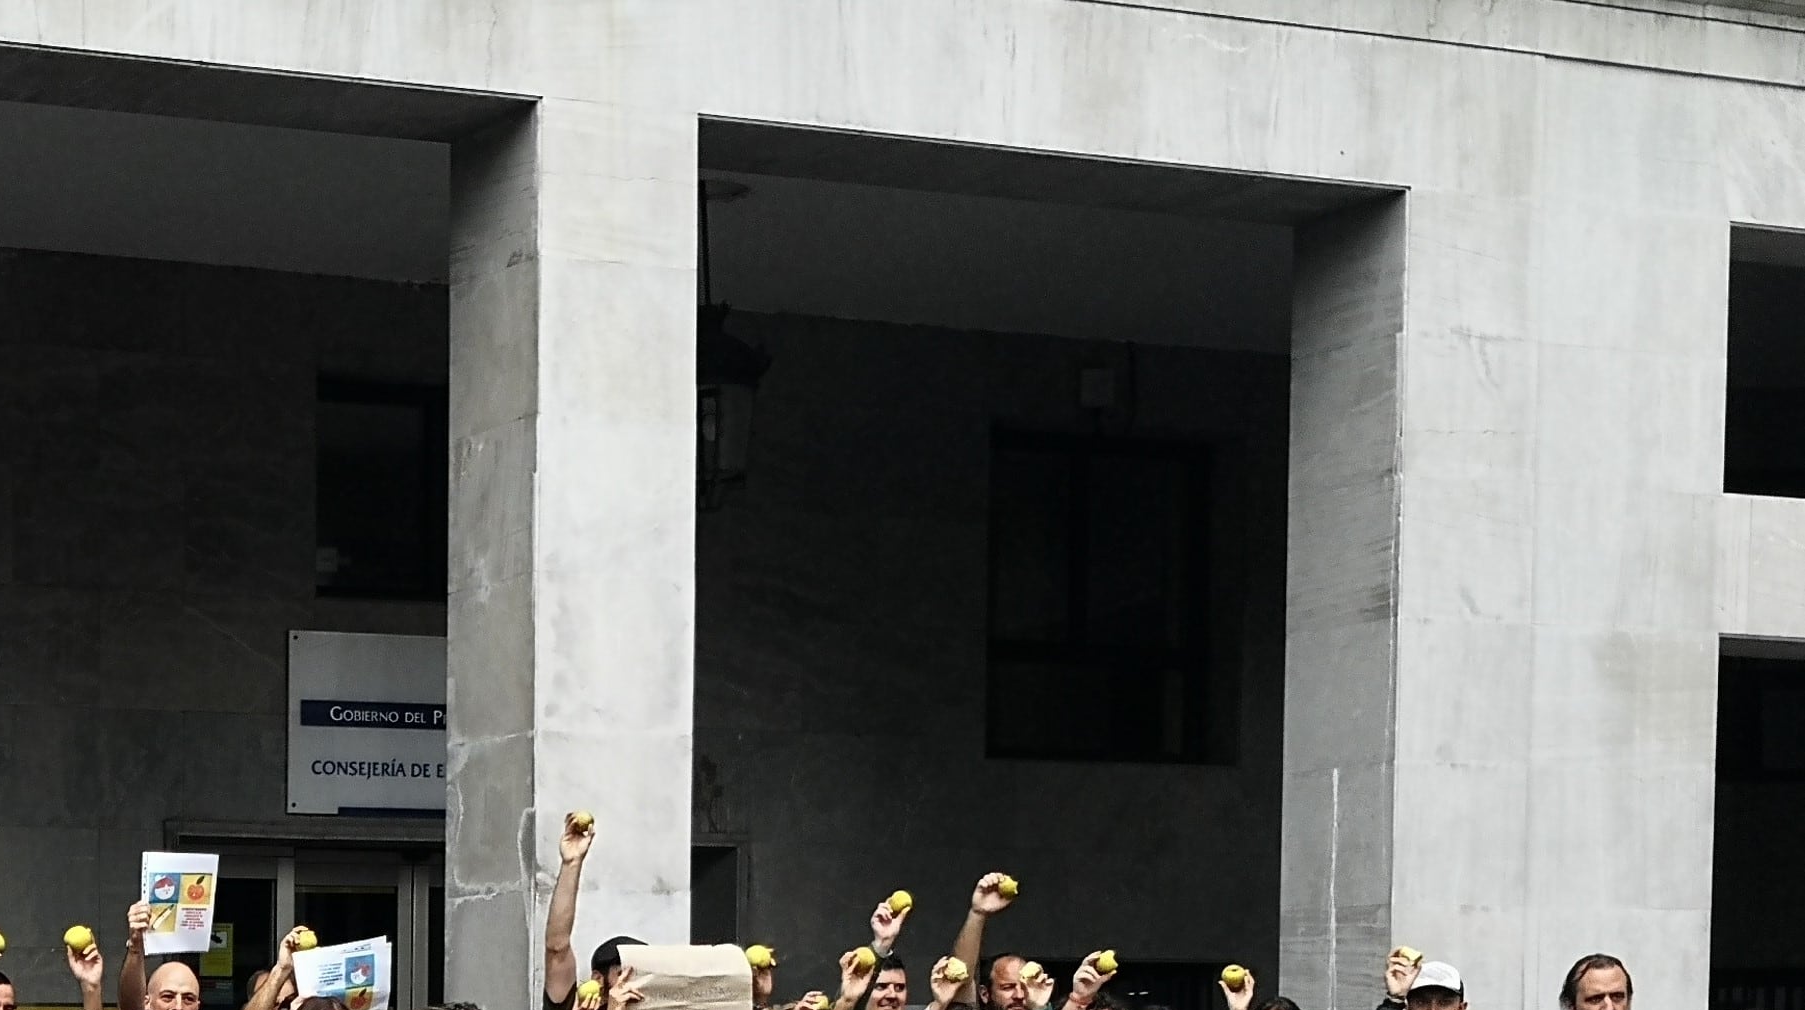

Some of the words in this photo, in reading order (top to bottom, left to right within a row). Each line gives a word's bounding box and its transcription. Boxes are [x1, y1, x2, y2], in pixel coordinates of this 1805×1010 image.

[329, 706, 399, 723] GOBIERNO
[404, 711, 427, 724] DEL
[311, 758, 407, 781] CONSEJERÍA
[410, 762, 431, 778] DE
